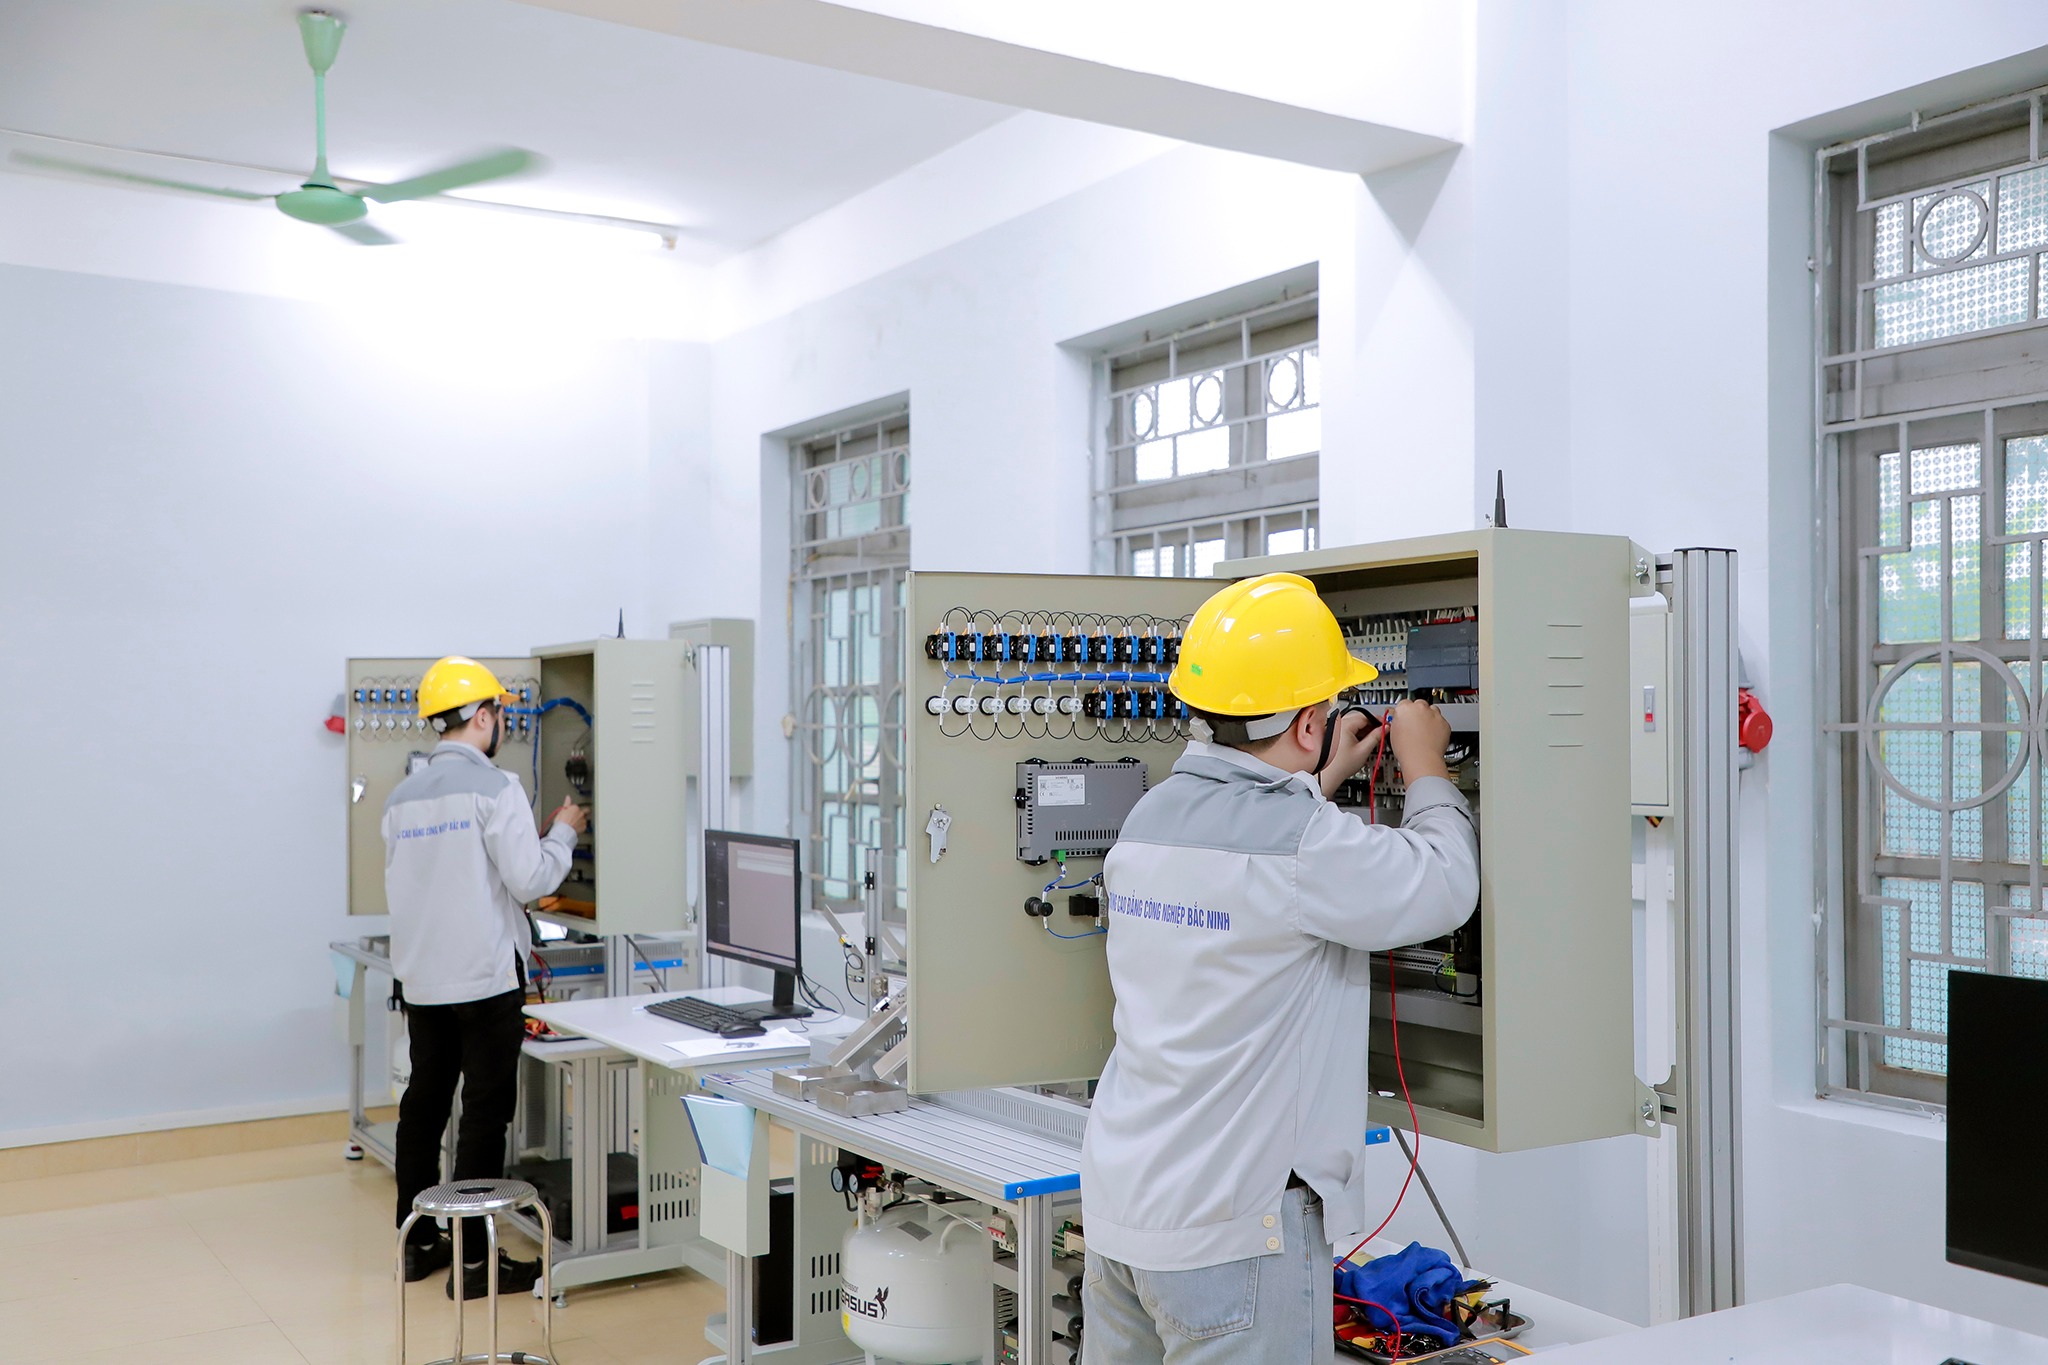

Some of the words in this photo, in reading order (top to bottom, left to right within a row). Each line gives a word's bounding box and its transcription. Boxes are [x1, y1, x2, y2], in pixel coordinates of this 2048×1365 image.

[1117, 895, 1127, 915] CAO
[1143, 897, 1161, 920] CÔNG
[1161, 902, 1186, 928] NGHIỆP
[1187, 901, 1204, 928] BẮC
[1206, 910, 1230, 931] NINH
